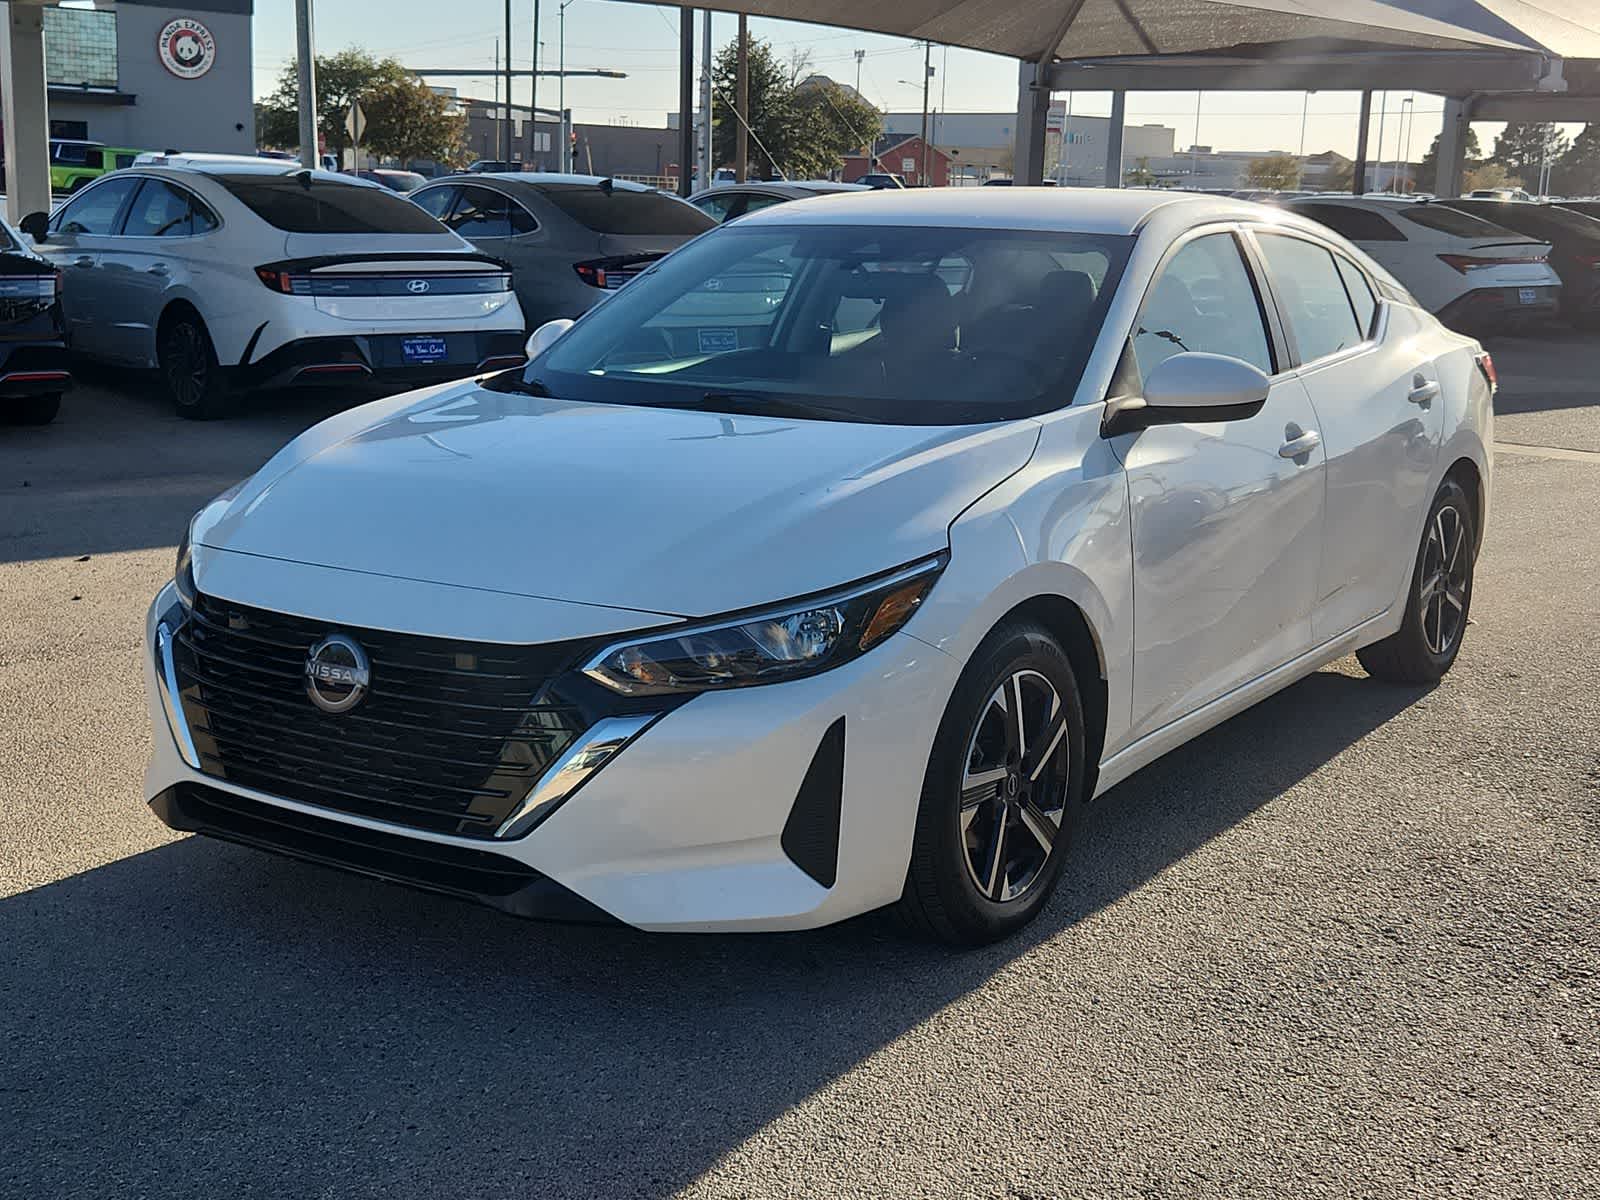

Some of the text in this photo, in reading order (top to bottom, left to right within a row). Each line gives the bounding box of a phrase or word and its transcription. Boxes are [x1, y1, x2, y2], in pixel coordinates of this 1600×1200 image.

[161, 21, 213, 50] PANDA EXPRESS
[306, 661, 368, 685] NISSAN
